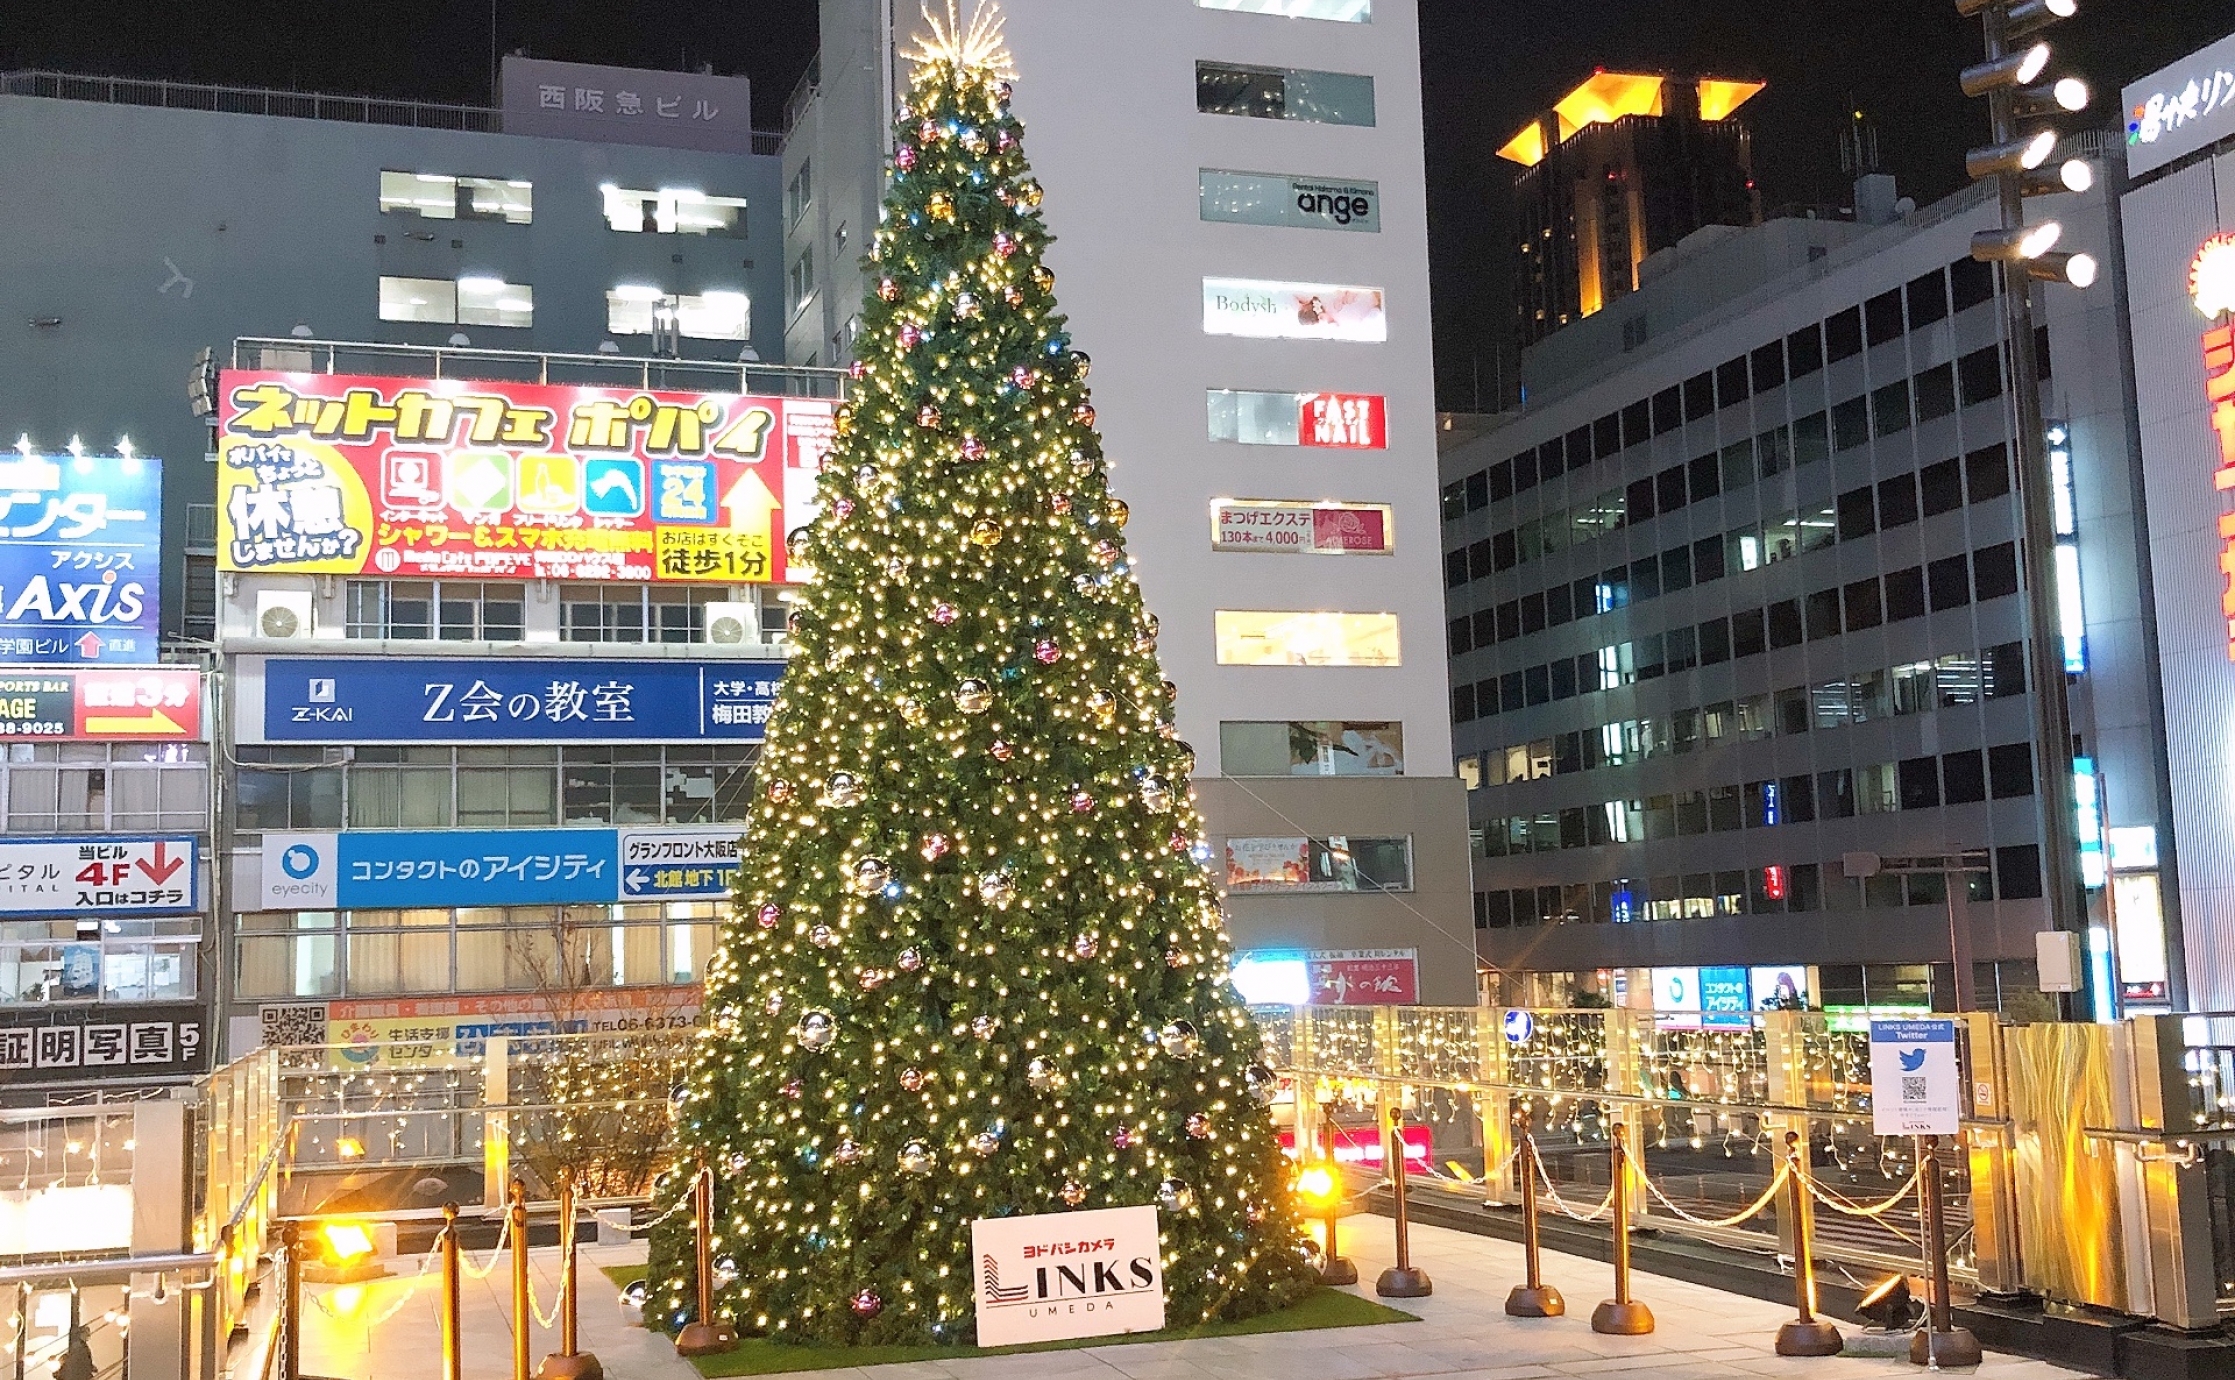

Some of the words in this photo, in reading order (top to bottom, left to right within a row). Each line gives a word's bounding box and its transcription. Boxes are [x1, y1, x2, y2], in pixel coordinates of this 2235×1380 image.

[539, 84, 719, 121] 西阪急ビル
[1297, 193, 1370, 225] ange
[230, 384, 548, 443] ネットカフェ
[568, 396, 769, 454] ポパイ
[1313, 394, 1370, 426] FAST
[1314, 420, 1371, 445] NAIL
[1221, 510, 1311, 526] まつげエクステ
[51, 551, 134, 570] アクシス
[661, 548, 768, 577] 徒歩1分
[6, 569, 145, 623] Axis
[42, 681, 69, 693] BAR
[423, 679, 635, 724] Z会の教室
[291, 707, 353, 723] Z-KAI
[78, 845, 128, 861] 当ビル
[629, 840, 738, 860] グランフロント大阪店
[75, 862, 131, 887] 4F
[352, 854, 606, 882] コンタクトのアイシティ
[75, 889, 184, 907] 入口はコチラ
[272, 883, 328, 898] eyecity
[1895, 1031, 1928, 1039] Twitter
[1023, 1238, 1115, 1259] ヨドバシカメラ
[983, 1253, 1154, 1305] LINKS
[1029, 1300, 1114, 1318] UMEDA
